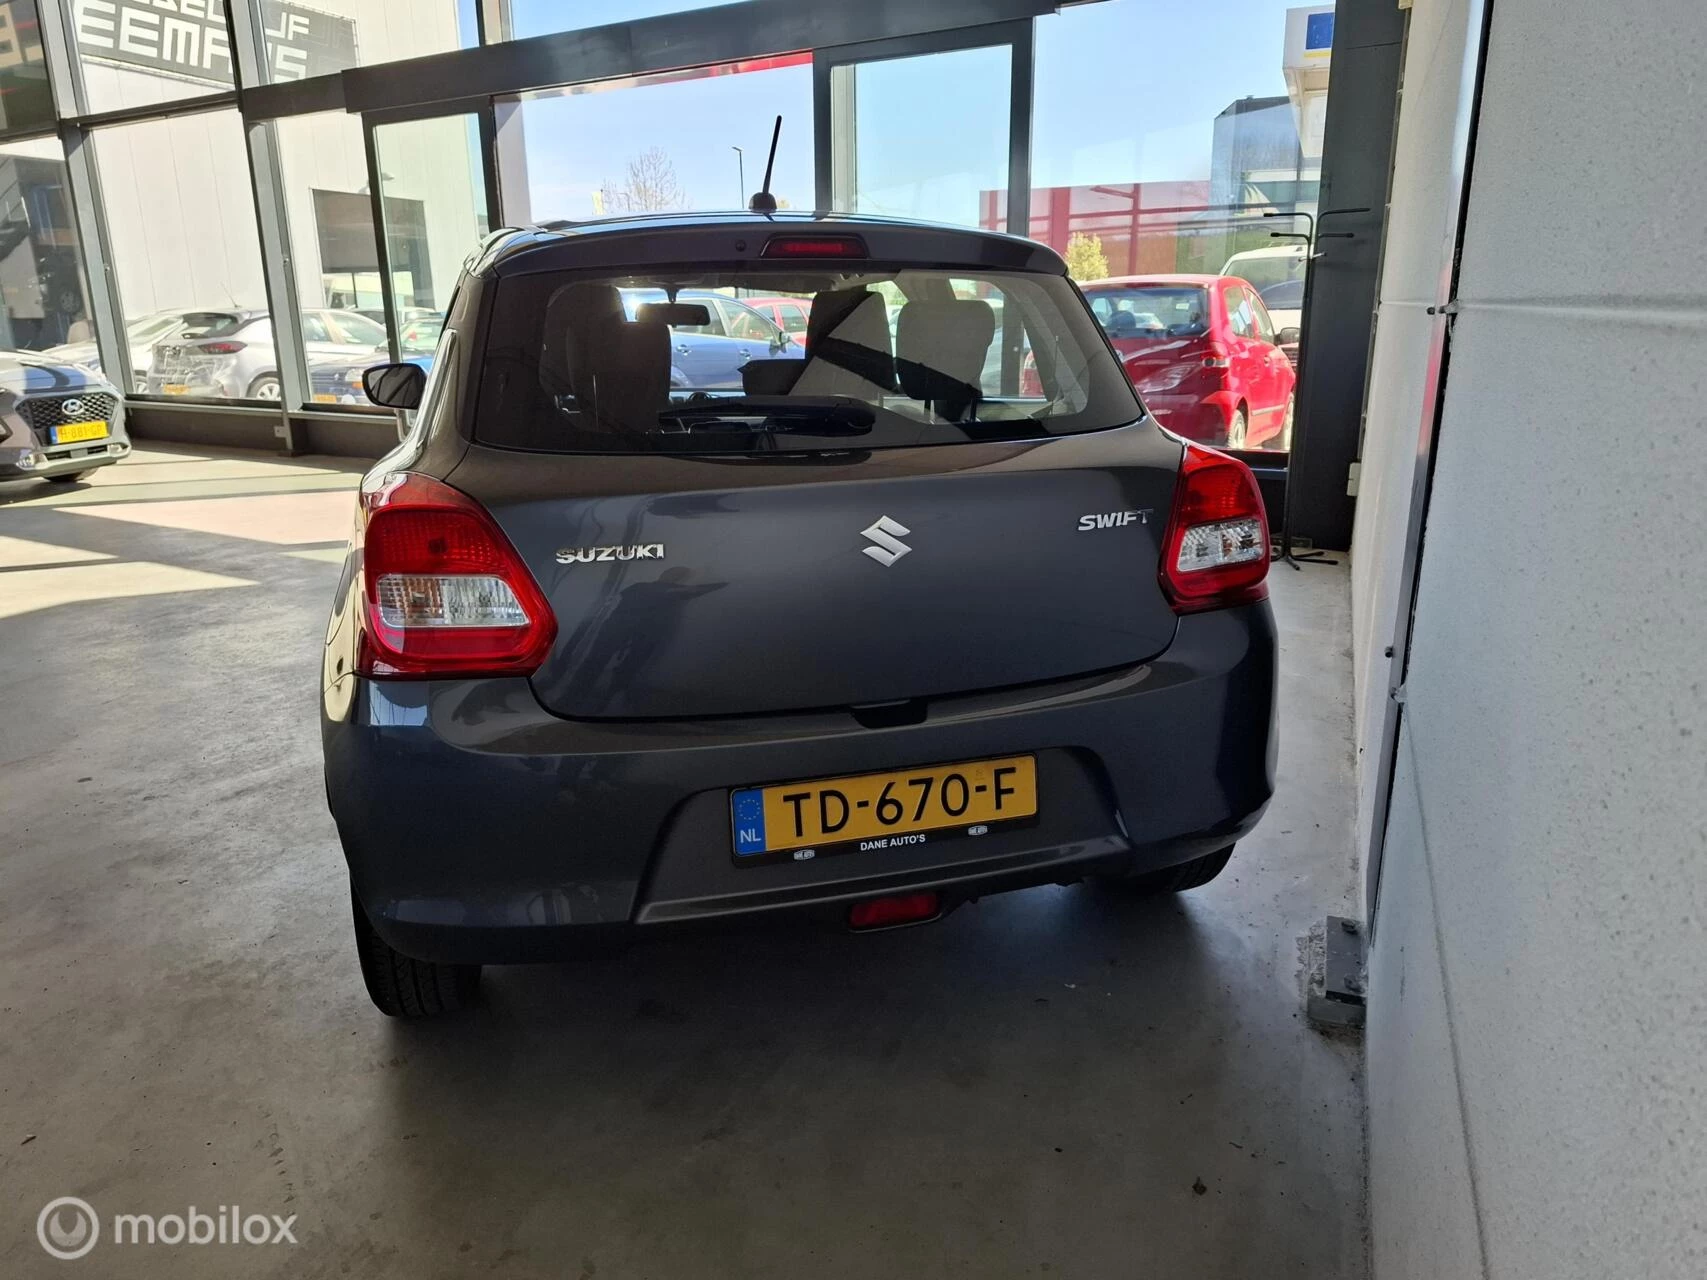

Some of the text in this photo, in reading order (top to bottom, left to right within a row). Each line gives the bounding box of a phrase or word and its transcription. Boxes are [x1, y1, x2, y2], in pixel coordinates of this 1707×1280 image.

[1078, 509, 1153, 531] SWIFT
[556, 544, 665, 564] SUZUKI
[783, 766, 1017, 838] TD-670-F
[740, 829, 763, 844] NL
[860, 834, 926, 852] DANE AUTO'S
